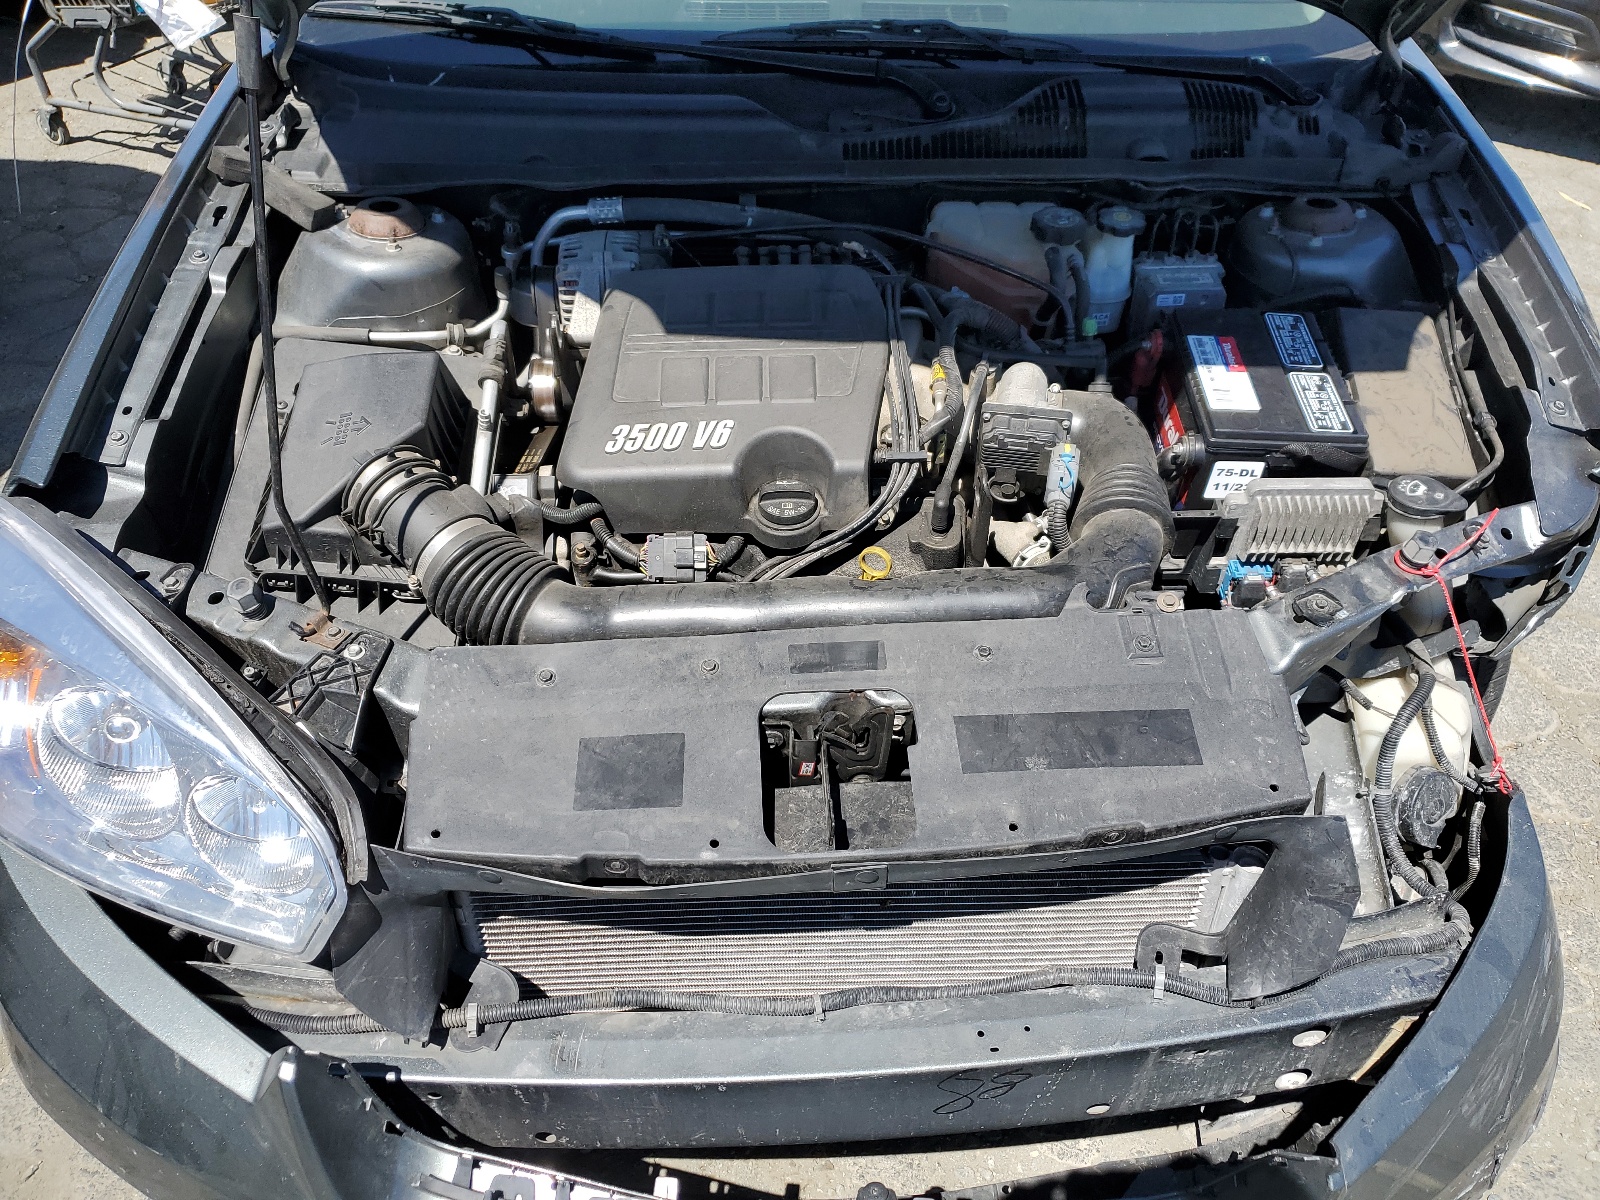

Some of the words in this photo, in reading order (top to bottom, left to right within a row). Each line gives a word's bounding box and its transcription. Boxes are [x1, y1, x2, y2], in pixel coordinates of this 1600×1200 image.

[1222, 342, 1239, 368] Duralast
[1158, 386, 1180, 446] Dural
[604, 421, 689, 455] 3500
[692, 419, 736, 450] V6
[1216, 468, 1258, 478] 75-DL
[766, 505, 781, 515] SAE
[784, 505, 807, 516] 5W-30
